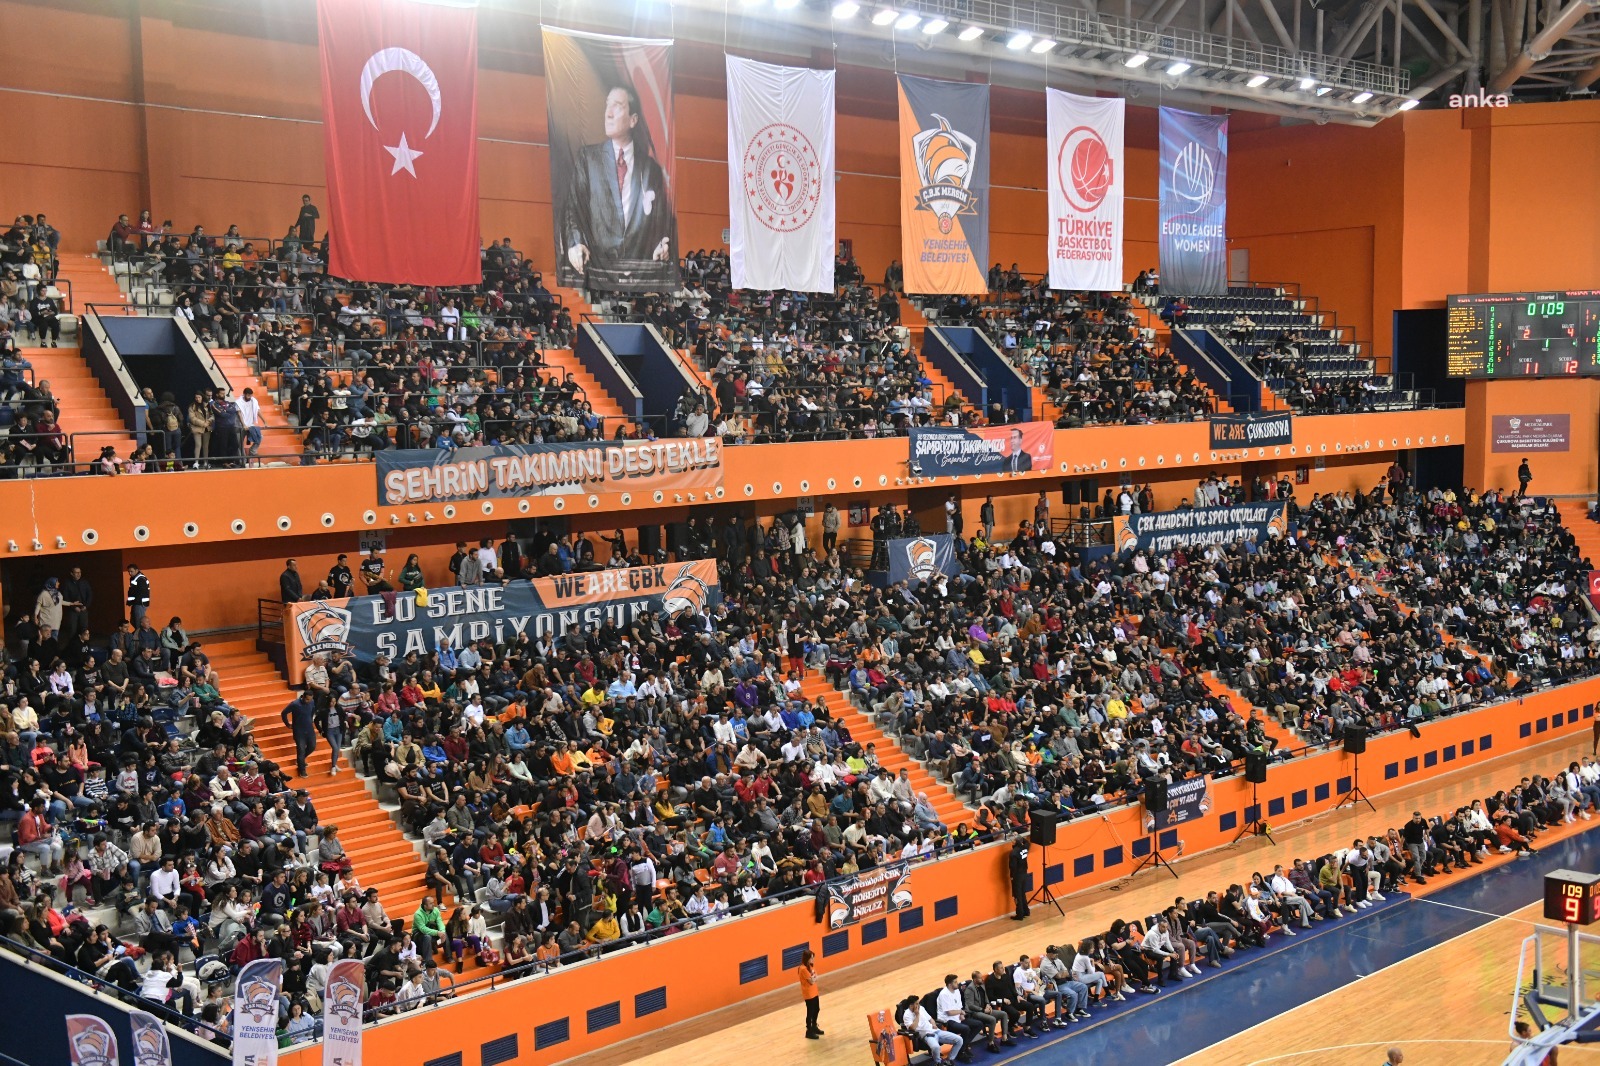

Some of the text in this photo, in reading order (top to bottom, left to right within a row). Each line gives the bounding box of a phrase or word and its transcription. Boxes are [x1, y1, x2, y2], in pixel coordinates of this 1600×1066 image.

[941, 186, 968, 203] MERSİN
[1057, 214, 1113, 238] TÜRKİYE
[1162, 221, 1223, 238] EUROLEAGUE
[1057, 236, 1112, 251] BASKETBOL
[1174, 238, 1210, 253] WOMEN
[920, 252, 970, 264] BELEDİYESİ
[1056, 248, 1112, 262] FEDERASYONU
[1523, 329, 1530, 339] 2
[1567, 328, 1574, 337] 4
[1565, 360, 1578, 373] 12
[1213, 420, 1290, 443] WE ARE ÇUKUROVA
[916, 440, 960, 458] ŞAMPİYON
[386, 438, 719, 504] ŞEHRİN TAKIMINI DESTEKLE
[1137, 516, 1155, 536] ÇBK
[1155, 510, 1194, 531] AKADEMİ
[1194, 512, 1207, 526] VE
[1208, 510, 1230, 525] SPOR
[427, 586, 506, 619] SENE
[323, 641, 346, 651] MERSİN
[852, 886, 887, 904] ROBERTO
[1566, 898, 1579, 921] 9
